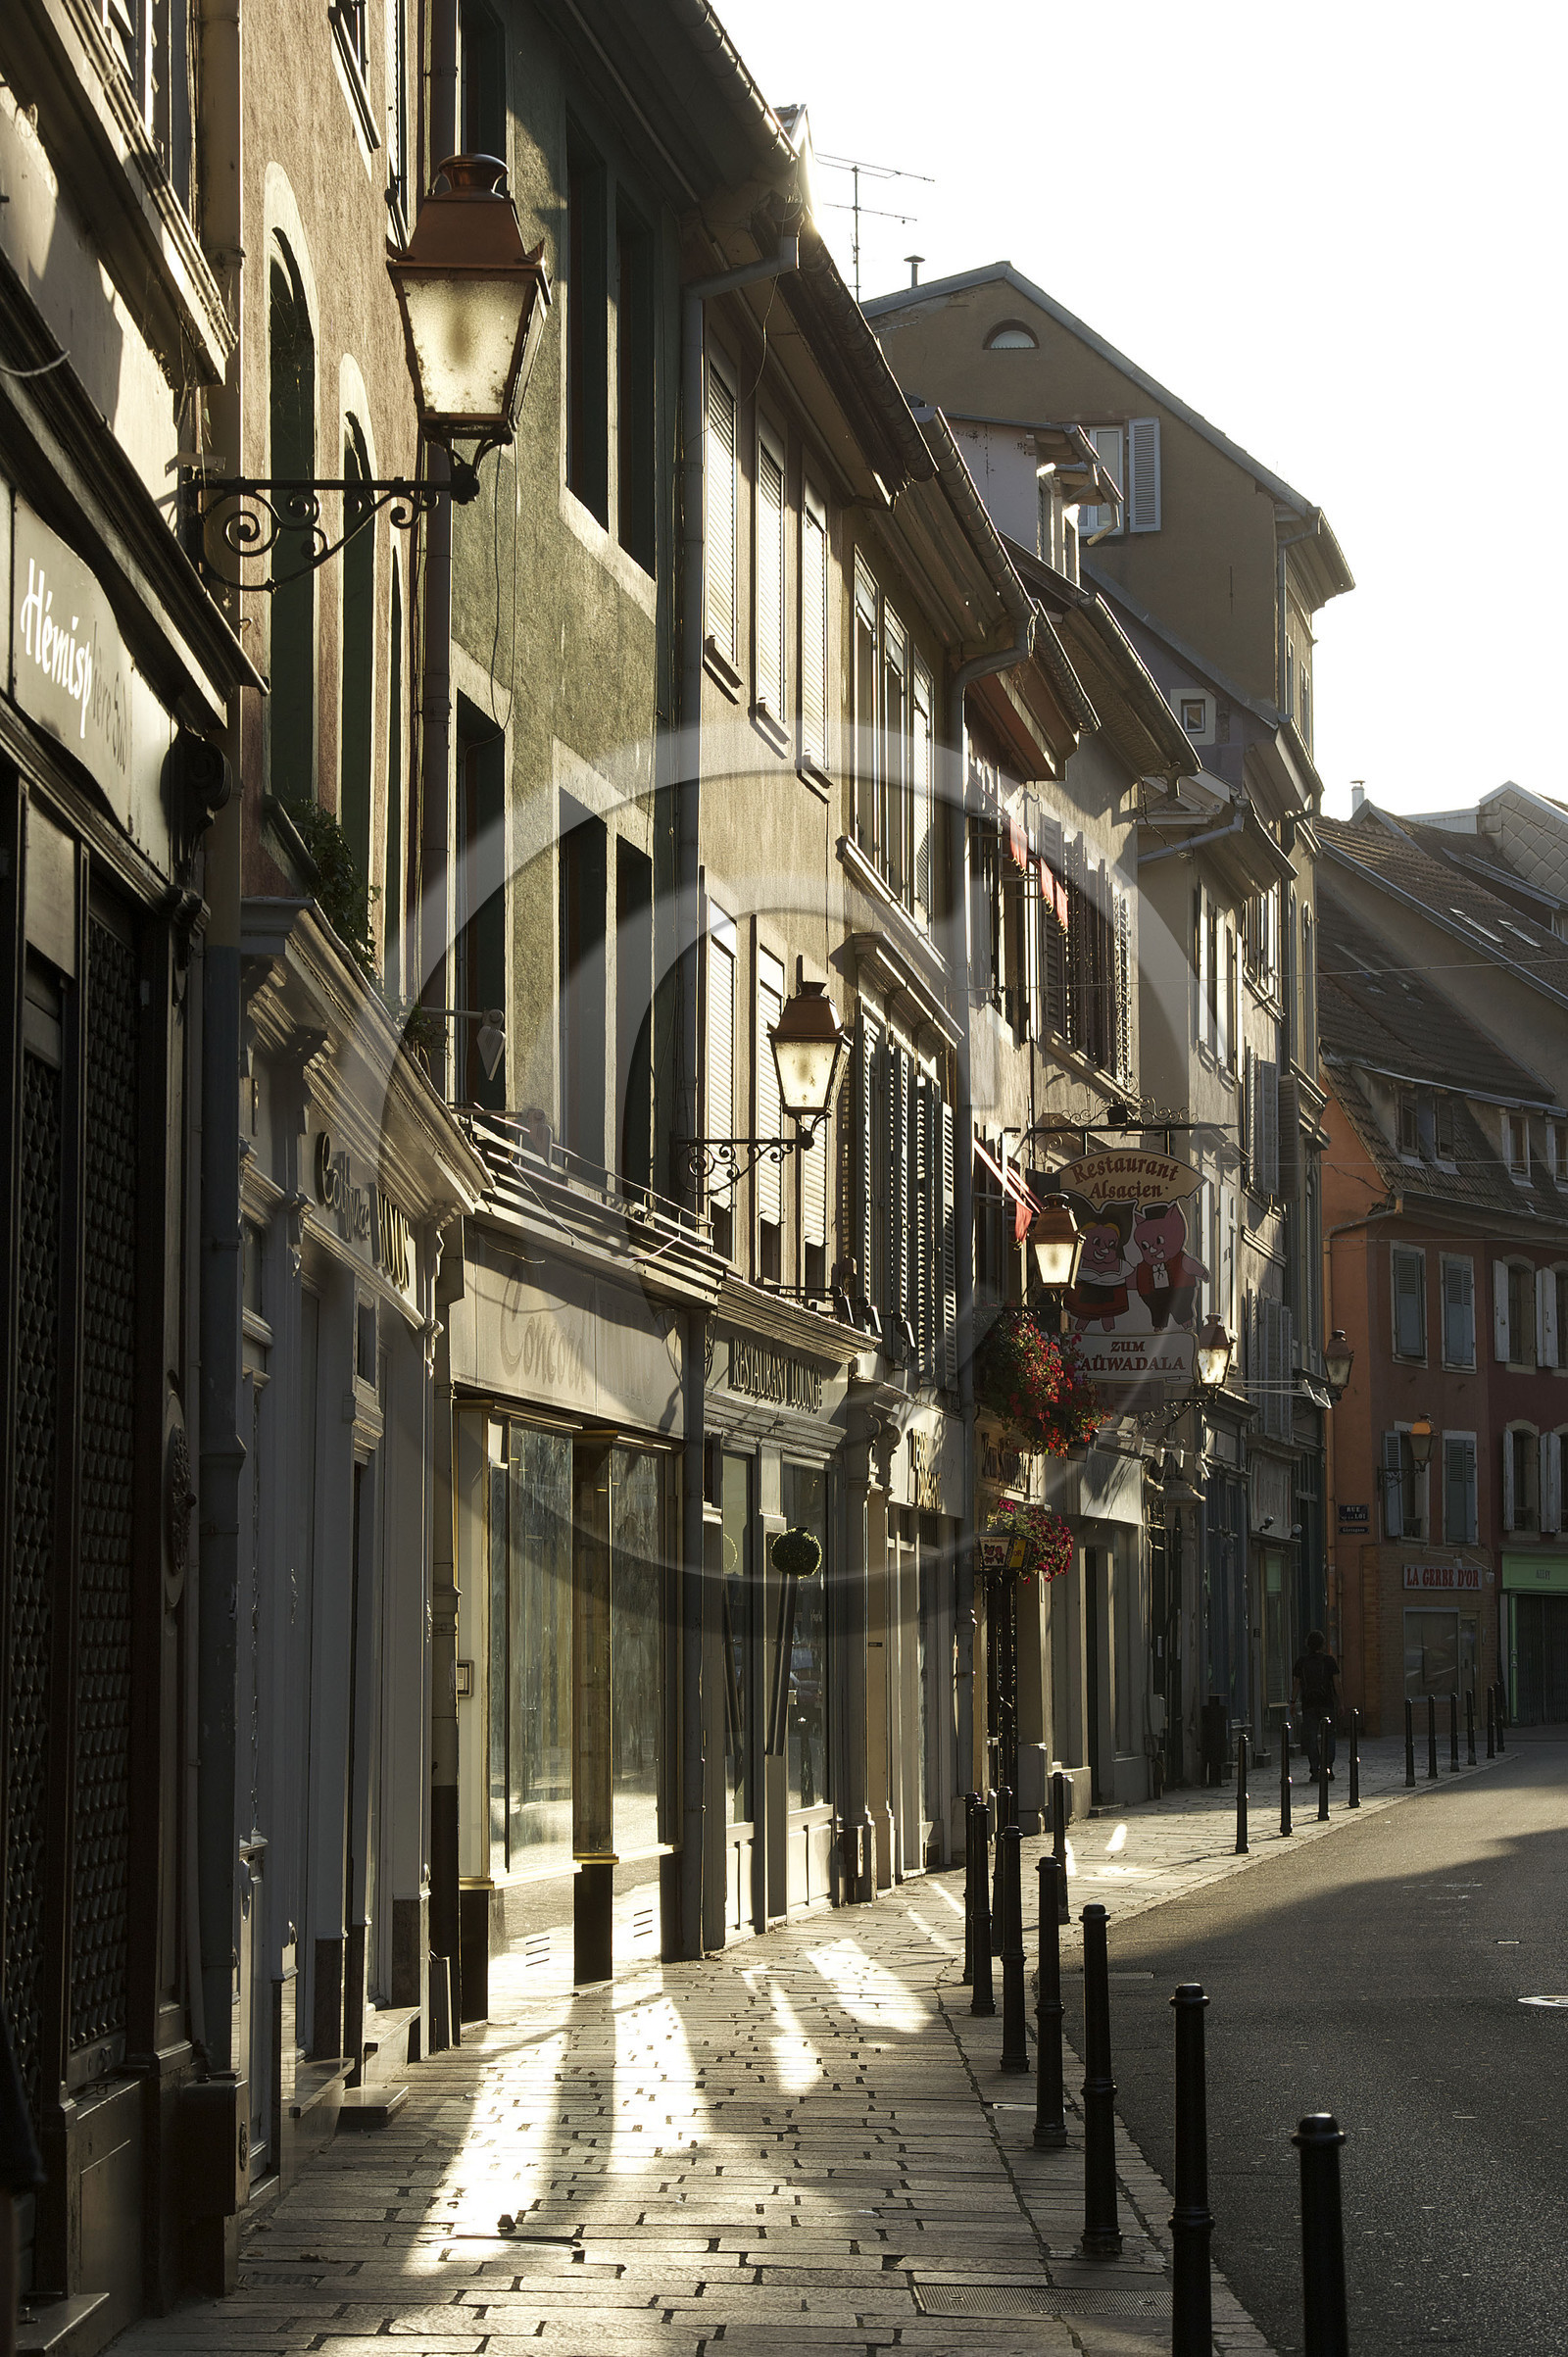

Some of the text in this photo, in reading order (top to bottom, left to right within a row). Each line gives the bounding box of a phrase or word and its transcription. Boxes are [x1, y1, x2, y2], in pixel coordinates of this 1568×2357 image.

[1070, 1154, 1180, 1185] Restaurant
[1088, 1179, 1163, 1200] Alsacien
[1109, 1340, 1146, 1352] ZUM
[1075, 1354, 1186, 1372] AÜWADALA
[728, 1338, 822, 1413] RESTAURANT LOUNGE
[1406, 1567, 1480, 1588] LA GERBE D'OR
